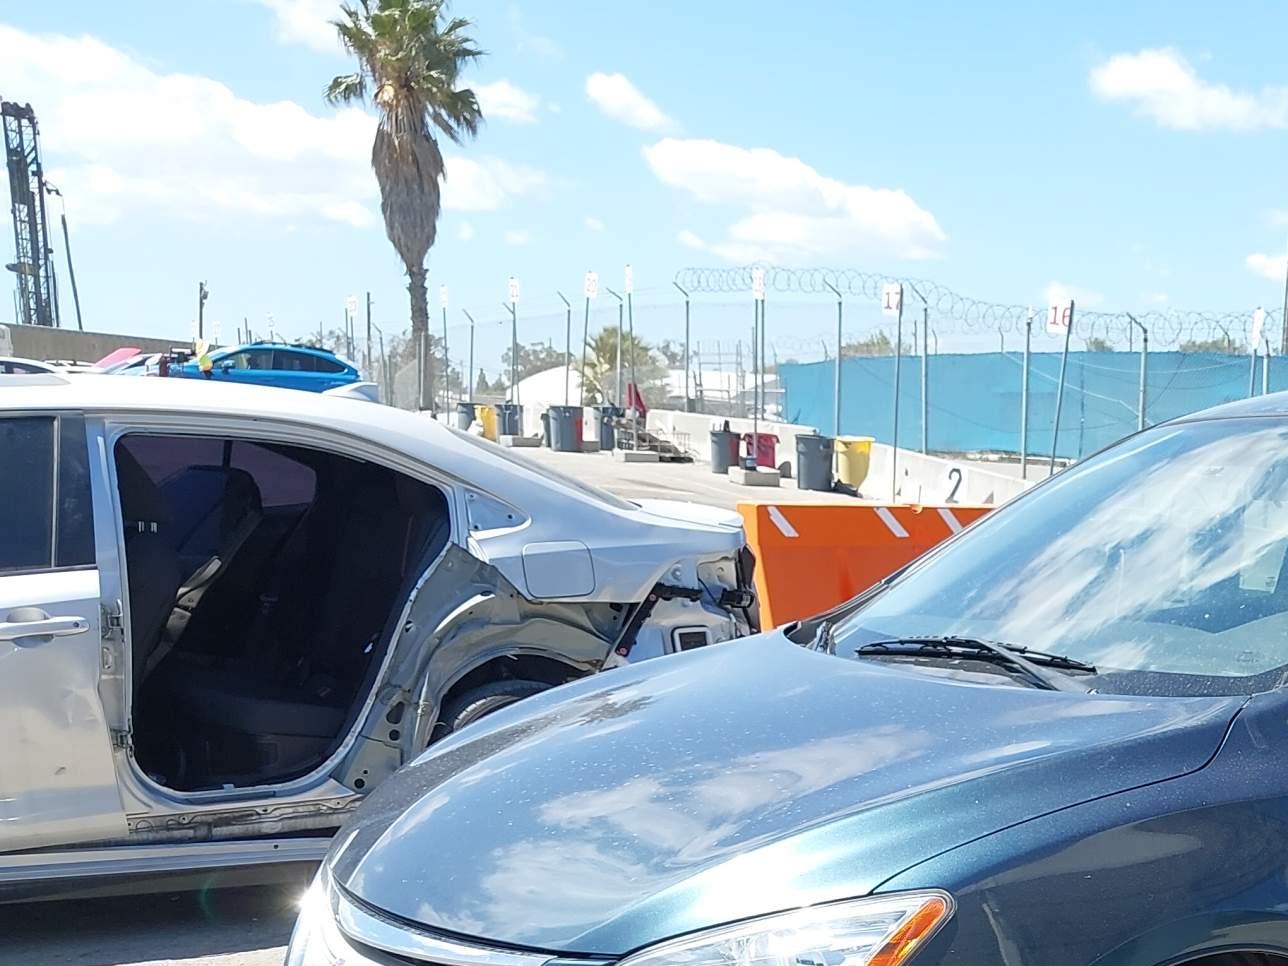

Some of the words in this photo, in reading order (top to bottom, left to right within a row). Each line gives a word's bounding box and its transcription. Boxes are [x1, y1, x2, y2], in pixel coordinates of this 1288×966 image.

[884, 291, 902, 310] 17
[1049, 305, 1071, 327] 16
[945, 468, 962, 504] 2
